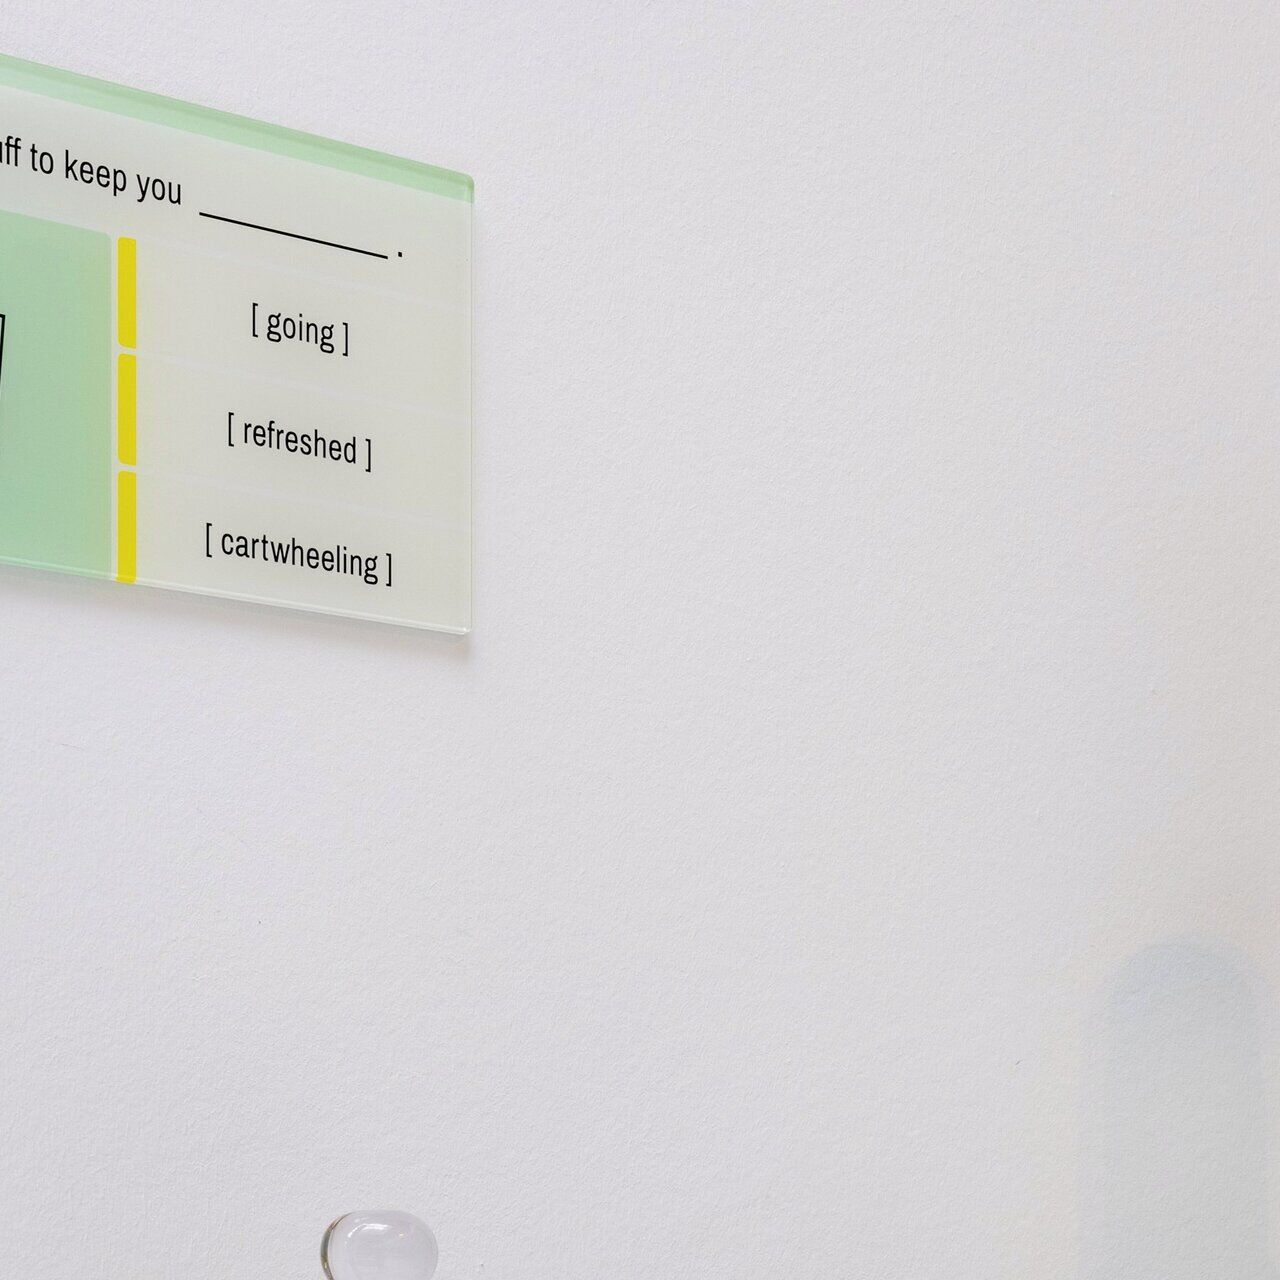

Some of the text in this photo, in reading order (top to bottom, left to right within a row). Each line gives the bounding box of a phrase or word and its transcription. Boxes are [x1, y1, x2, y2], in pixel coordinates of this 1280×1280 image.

[29, 143, 54, 175] to
[65, 149, 127, 197] keep
[136, 173, 181, 206] you
[266, 312, 335, 354] going
[244, 420, 357, 465] refreshed
[221, 533, 379, 586] cartwheeling
